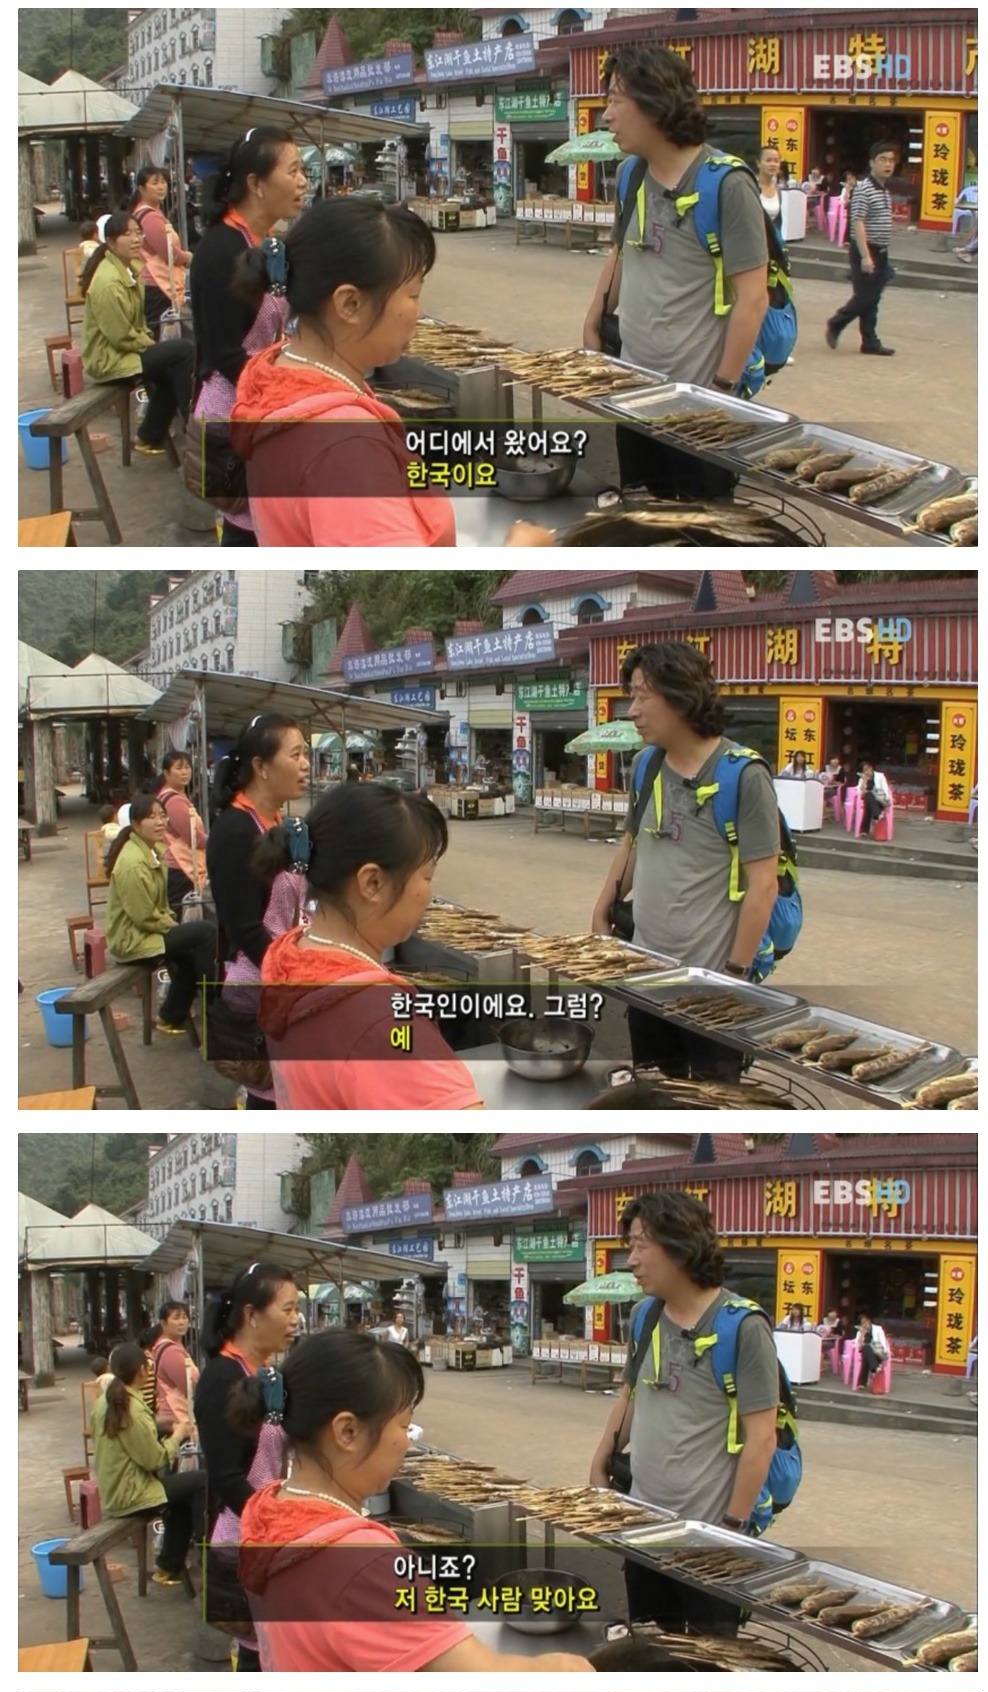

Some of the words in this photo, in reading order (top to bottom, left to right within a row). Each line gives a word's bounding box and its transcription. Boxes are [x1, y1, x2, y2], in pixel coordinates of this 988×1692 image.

[427, 41, 515, 70] 东江湖干鱼土特产店
[496, 127, 507, 159] 干鱼
[932, 143, 951, 210] 玲珑茶
[447, 629, 535, 659] 东江湖干鱼土特产店
[515, 716, 527, 749] 干鱼
[948, 734, 967, 801] 玲珑茶
[446, 1181, 533, 1210] 东江湖干鱼土特产店
[513, 1267, 525, 1299] 干鱼
[946, 1287, 965, 1354] 玲珑茶
